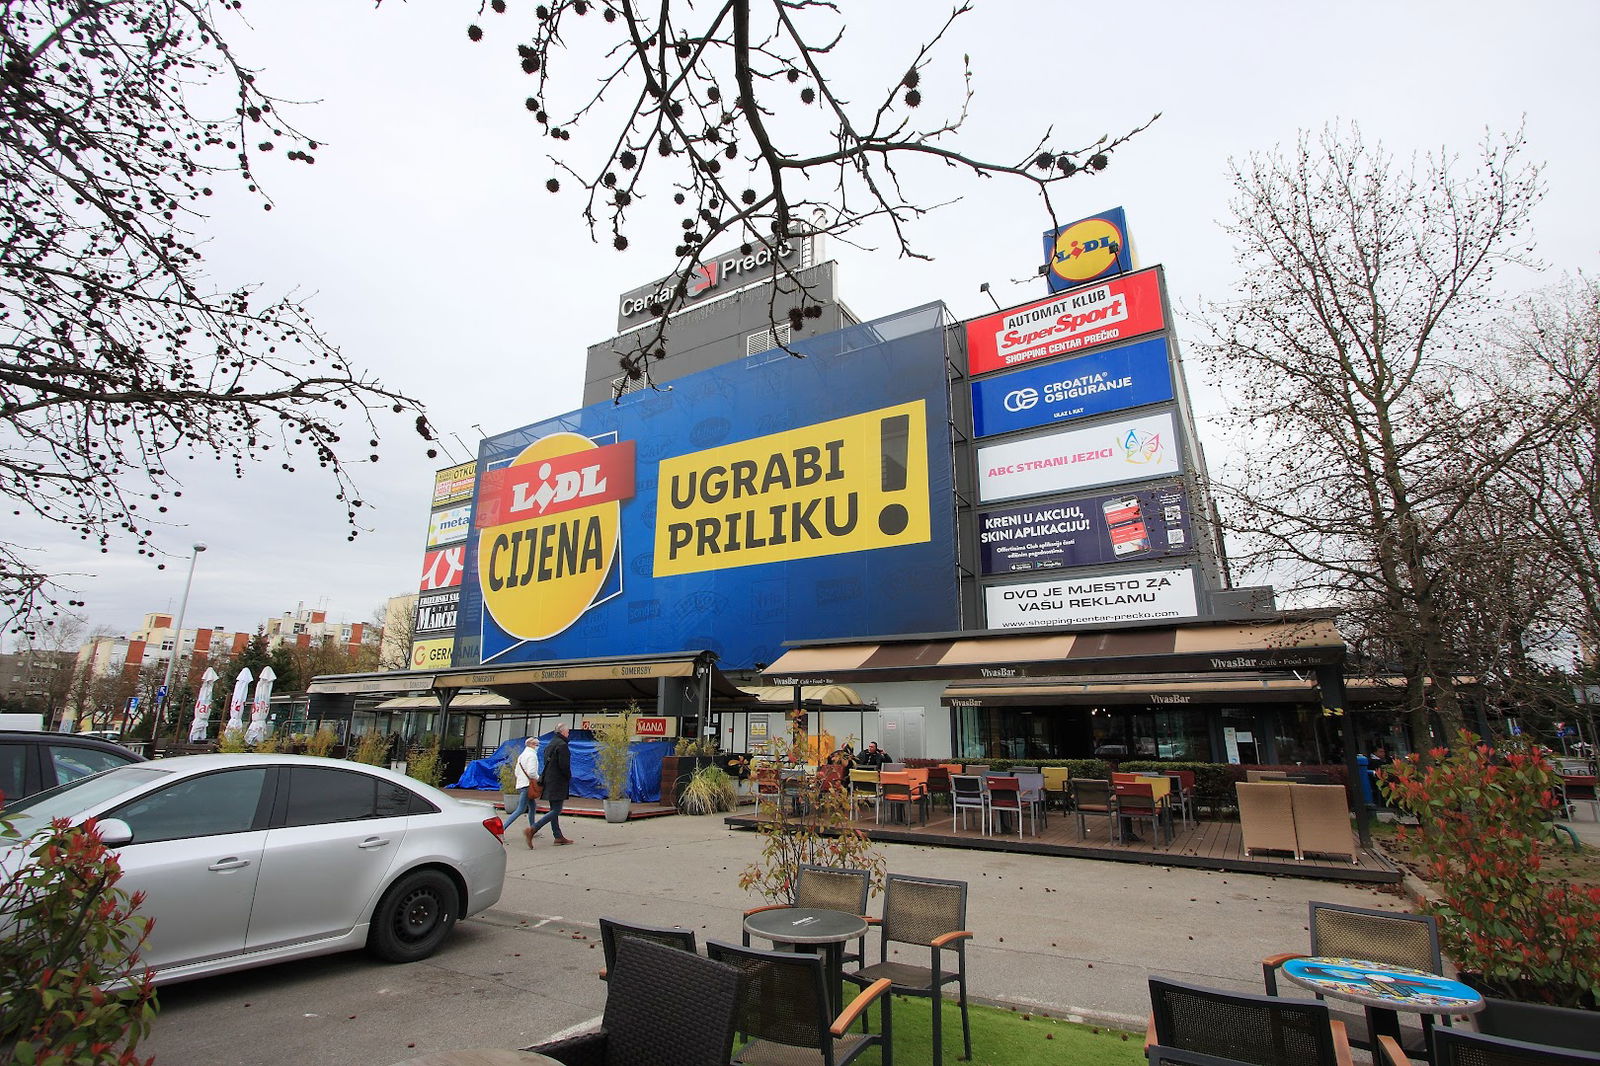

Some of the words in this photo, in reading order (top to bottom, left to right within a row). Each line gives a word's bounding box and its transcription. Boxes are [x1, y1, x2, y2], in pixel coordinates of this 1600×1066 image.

[1008, 301, 1067, 330] AUTOMAT
[1072, 289, 1106, 310] KLUB
[1001, 299, 1122, 349] SuperSport
[1005, 347, 1047, 364] SHOPPING
[1048, 339, 1082, 354] CENTAR
[1084, 328, 1120, 345] PREČKO
[1044, 376, 1133, 404] OSIGURANJE
[670, 439, 845, 510] UGRABI
[988, 465, 1015, 478] ABC
[1016, 455, 1068, 473] STRANI
[1070, 448, 1113, 466] JEZICI
[668, 491, 859, 561] PRILIKU
[985, 512, 1022, 530] KRENI
[1023, 511, 1034, 525] U
[1035, 506, 1084, 524] AKCIJU,
[980, 528, 1015, 544] SKINI
[1015, 519, 1090, 540] APLIKACIJU!
[488, 515, 603, 592] CIJENA
[1003, 588, 1038, 600] OVO
[1042, 587, 1062, 597] JE
[1067, 579, 1140, 595] MJESTO
[1145, 577, 1172, 588] ZA
[1018, 598, 1064, 612] VAŠU
[1069, 592, 1156, 608] REKLAMU
[1001, 610, 1180, 628] www.shopping-centar-precko.com
[621, 666, 652, 676] SOMERSBY
[980, 667, 1016, 677] VivasBar
[1210, 657, 1257, 669] VivasBar
[541, 670, 568, 680] SOMERSBY
[773, 677, 799, 685] VivasBar
[951, 698, 983, 707] VivasBar
[1150, 694, 1190, 704] VivasBar
